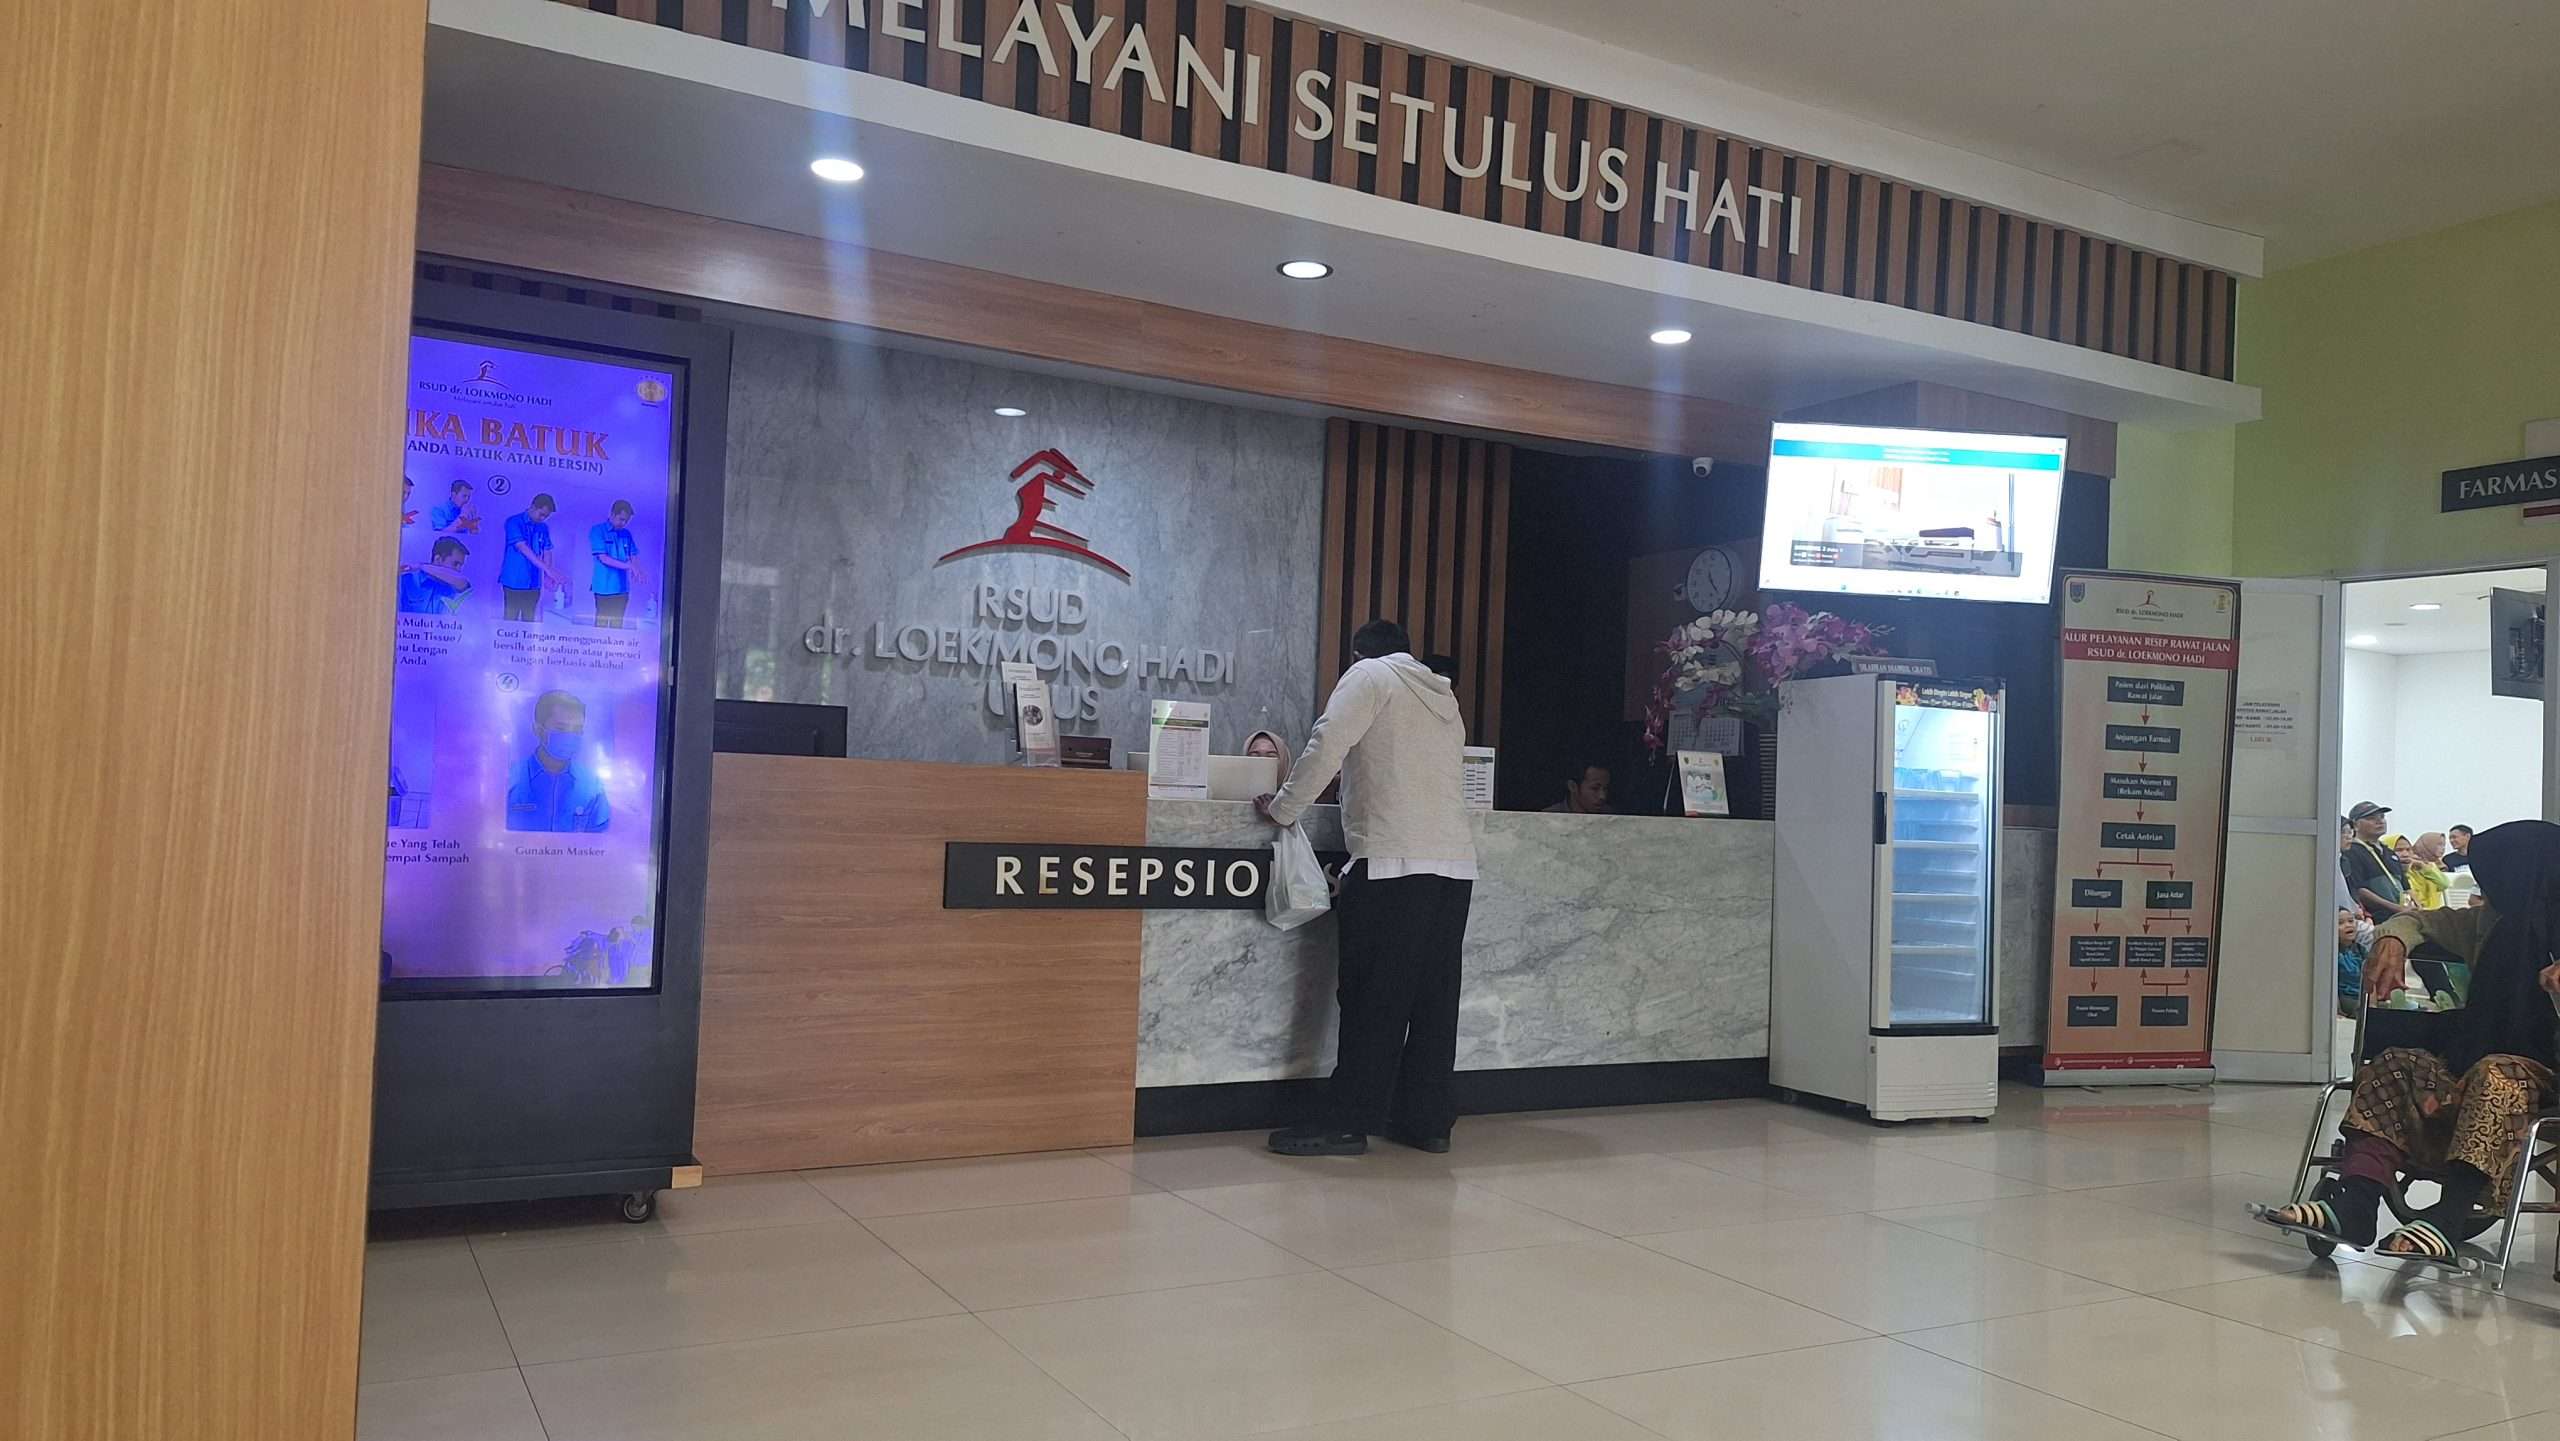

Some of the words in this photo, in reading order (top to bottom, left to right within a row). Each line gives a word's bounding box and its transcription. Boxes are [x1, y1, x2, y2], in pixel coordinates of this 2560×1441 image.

[1294, 69, 1629, 213] SETULUS
[1654, 160, 1802, 255] HATI
[480, 417, 609, 460] BATUK
[407, 440, 450, 455] ANDA
[454, 445, 503, 462] BATUK
[506, 452, 544, 466] ATAU
[548, 457, 604, 475] BERSIN)
[977, 583, 1088, 625] RSUD
[496, 628, 519, 638] Cuci
[2064, 631, 2088, 643] ALUR
[2089, 633, 2142, 646] PELAYANAN
[2144, 636, 2169, 648] RESEP
[2170, 639, 2200, 650] RAWAT
[2201, 641, 2231, 653] JALAN
[803, 622, 863, 656] dr.
[873, 621, 1130, 677] LOEKMONO
[1137, 643, 1236, 685] HADI
[2087, 647, 2115, 658] RSUD
[2128, 651, 2180, 663] LOEKMONO
[2182, 654, 2206, 665] HADI
[400, 838, 428, 852] Yang
[431, 839, 460, 849] Telah
[424, 853, 471, 866] Sampah
